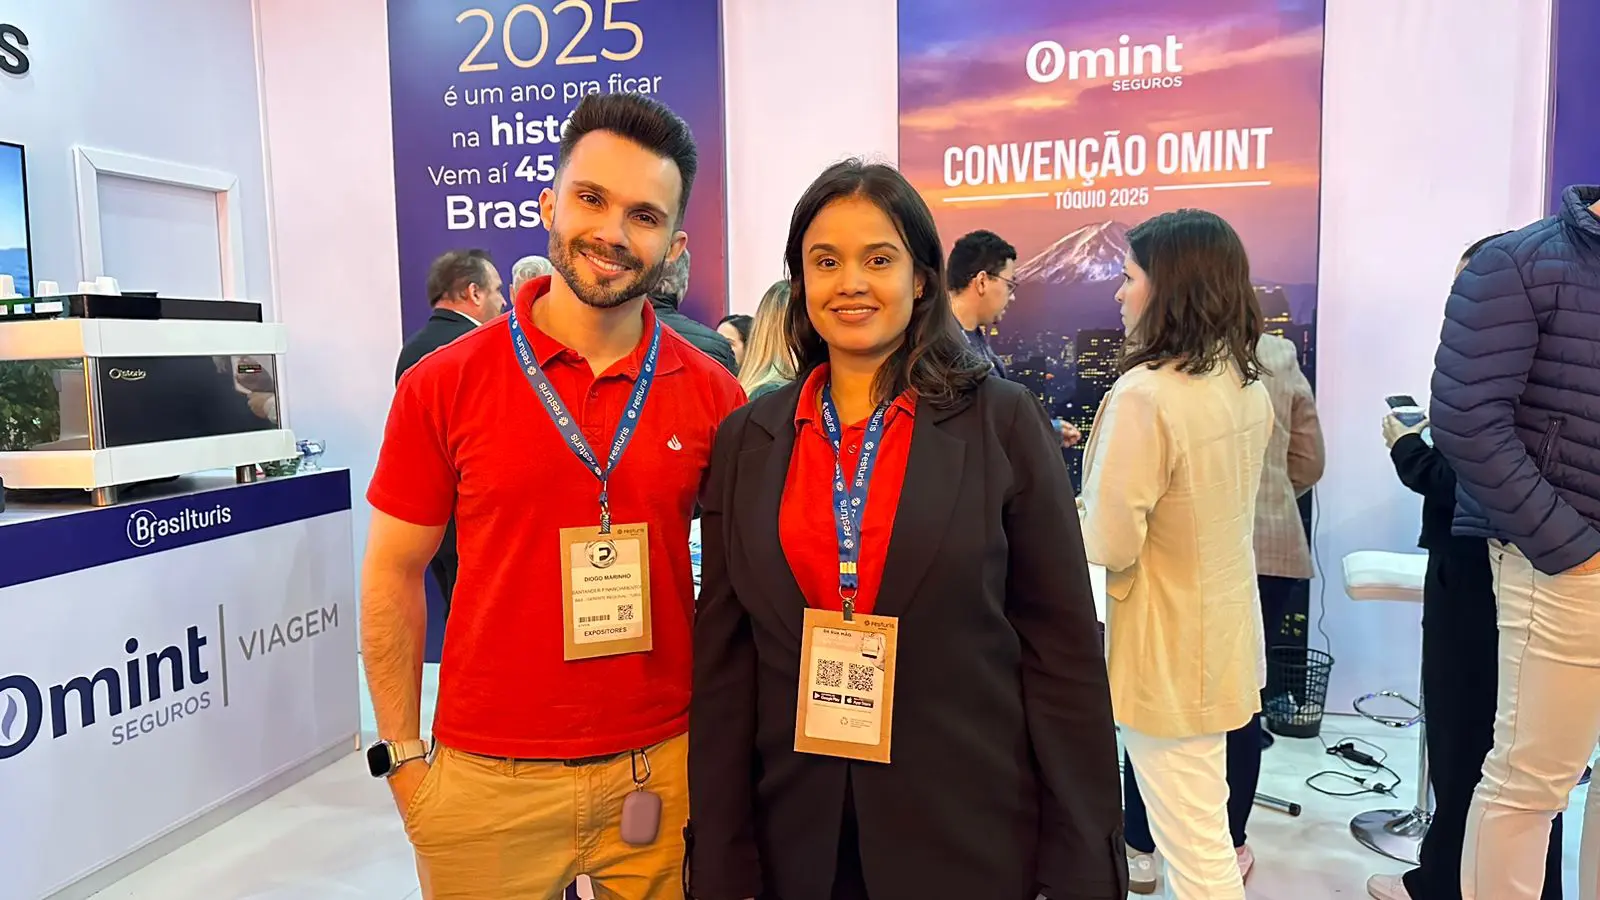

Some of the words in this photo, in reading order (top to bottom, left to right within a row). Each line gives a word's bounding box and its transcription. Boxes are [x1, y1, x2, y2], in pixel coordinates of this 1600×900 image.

[455, 0, 644, 73] 2025
[1025, 34, 1184, 83] Omint
[444, 86, 458, 107] é
[465, 85, 504, 105] um
[511, 83, 556, 103] ano
[563, 80, 601, 104] pra
[608, 73, 662, 95] ficar
[1112, 76, 1183, 92] SEGUROS
[452, 130, 480, 149] na
[943, 129, 1147, 187] CONVENÇÃO
[1156, 127, 1274, 175] OMINT
[427, 165, 481, 187] Vem
[488, 162, 509, 184] aí
[514, 154, 556, 182] 45
[1054, 188, 1107, 211] TÓQUIO
[1109, 187, 1149, 208] 2025
[134, 504, 232, 542] Brasilturis
[238, 603, 339, 661] VIAGEM
[584, 627, 627, 637] EXPOSITORES
[0, 625, 209, 760] Omint
[111, 691, 211, 746] SEGUROS
